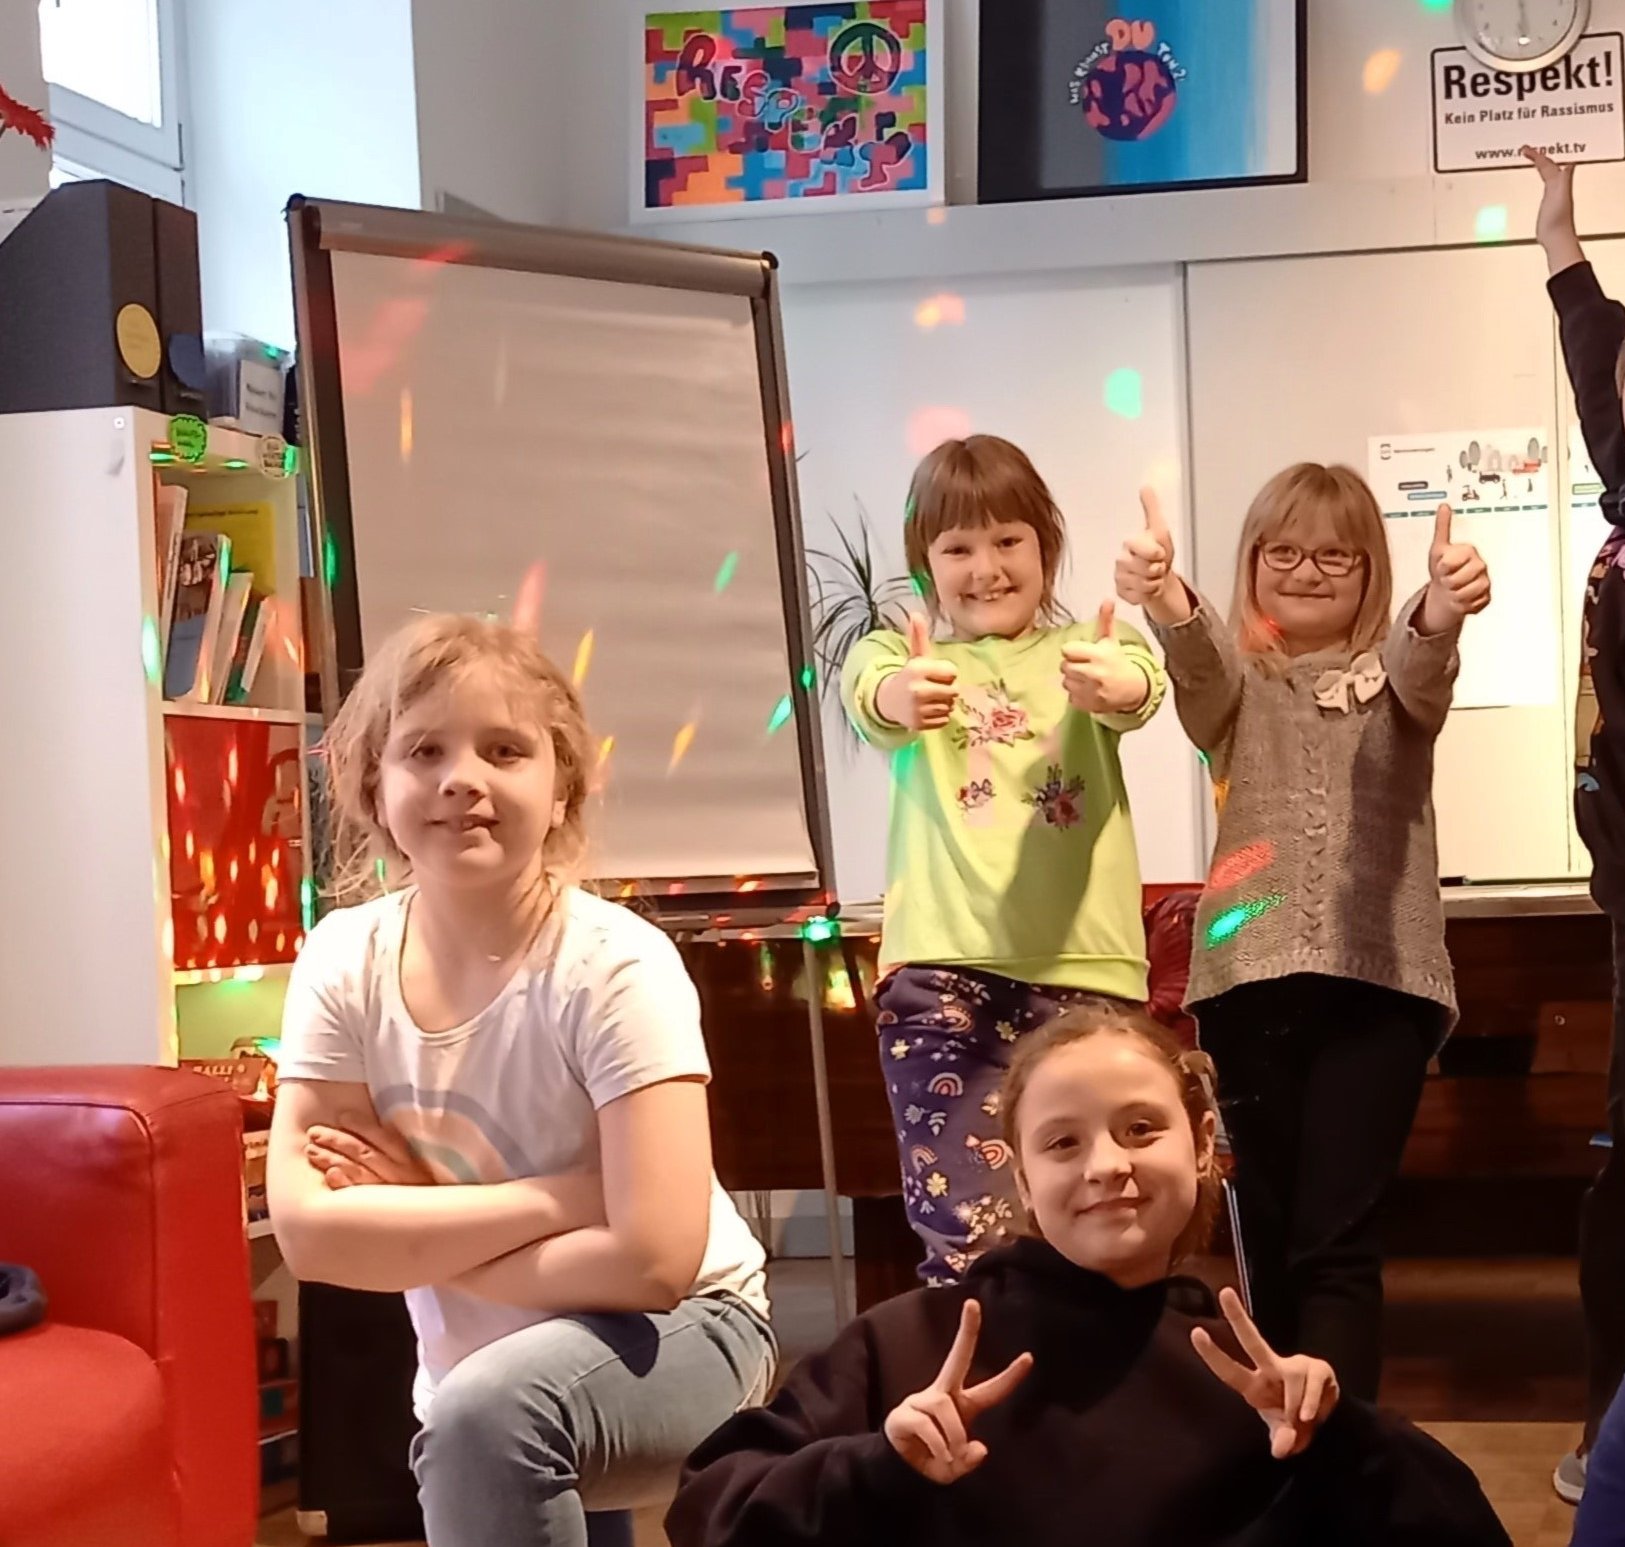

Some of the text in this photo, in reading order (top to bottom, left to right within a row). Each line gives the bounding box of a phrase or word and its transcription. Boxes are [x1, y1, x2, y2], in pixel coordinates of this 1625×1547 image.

[1105, 18, 1154, 51] DU
[1443, 51, 1613, 101] Respekt!
[1444, 102, 1614, 125] Kein Platz für Rassismus
[1475, 142, 1586, 159] www.rpekt.tv
